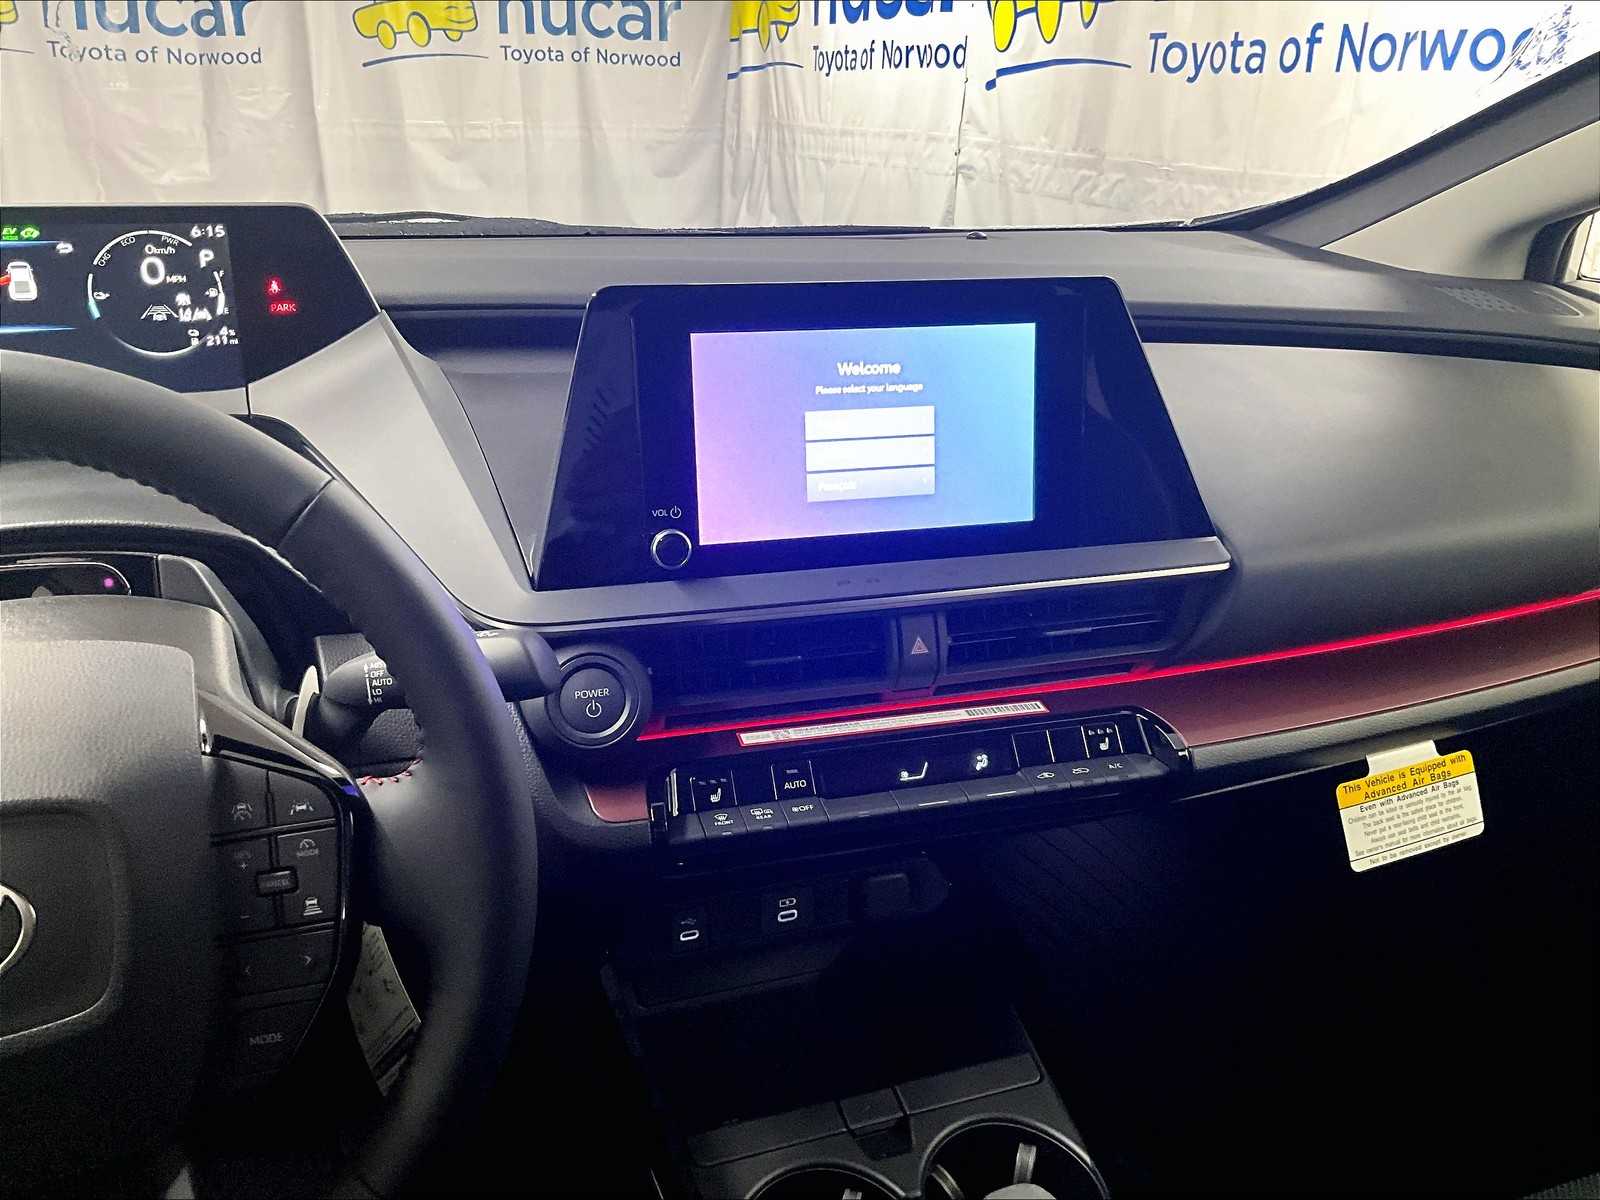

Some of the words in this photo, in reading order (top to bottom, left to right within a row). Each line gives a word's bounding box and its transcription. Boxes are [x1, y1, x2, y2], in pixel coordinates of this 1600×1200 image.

[135, 44, 158, 63] of
[167, 48, 262, 65] Norwood
[1148, 31, 1266, 84] Toyota
[1279, 22, 1324, 73] of
[1336, 10, 1570, 73] Norwo
[500, 45, 564, 64] Toyota
[571, 47, 589, 63] of
[597, 48, 681, 67] Norwood
[813, 45, 857, 77] Toyota
[861, 40, 875, 70] of
[190, 225, 226, 238] 6:15
[120, 236, 136, 247] ECO
[161, 235, 179, 246] PWR
[98, 252, 111, 267] CHG
[199, 248, 215, 268] P
[140, 256, 166, 286] 0
[166, 275, 187, 284] MPH
[270, 303, 297, 312] PARK
[837, 361, 901, 376] Welcome
[651, 509, 669, 517] VOL
[370, 670, 385, 678] OFF
[372, 677, 393, 686] AUTO
[372, 688, 383, 696] LO
[574, 687, 610, 699] POWER
[1343, 785, 1362, 795] This
[1365, 773, 1395, 788] Vehicle
[1399, 771, 1406, 779] is
[1410, 760, 1447, 777] Equipped
[1449, 754, 1466, 764] with
[784, 779, 807, 790] AUTO
[1363, 782, 1407, 801] Advanced
[1412, 776, 1425, 787] Air
[1430, 769, 1451, 782] Bags
[1360, 803, 1377, 813] Even
[1379, 798, 1394, 807] with
[1397, 788, 1428, 802] Advanced
[1443, 780, 1460, 789] Bags
[799, 804, 814, 812] OFF
[248, 1032, 284, 1047] MODE
